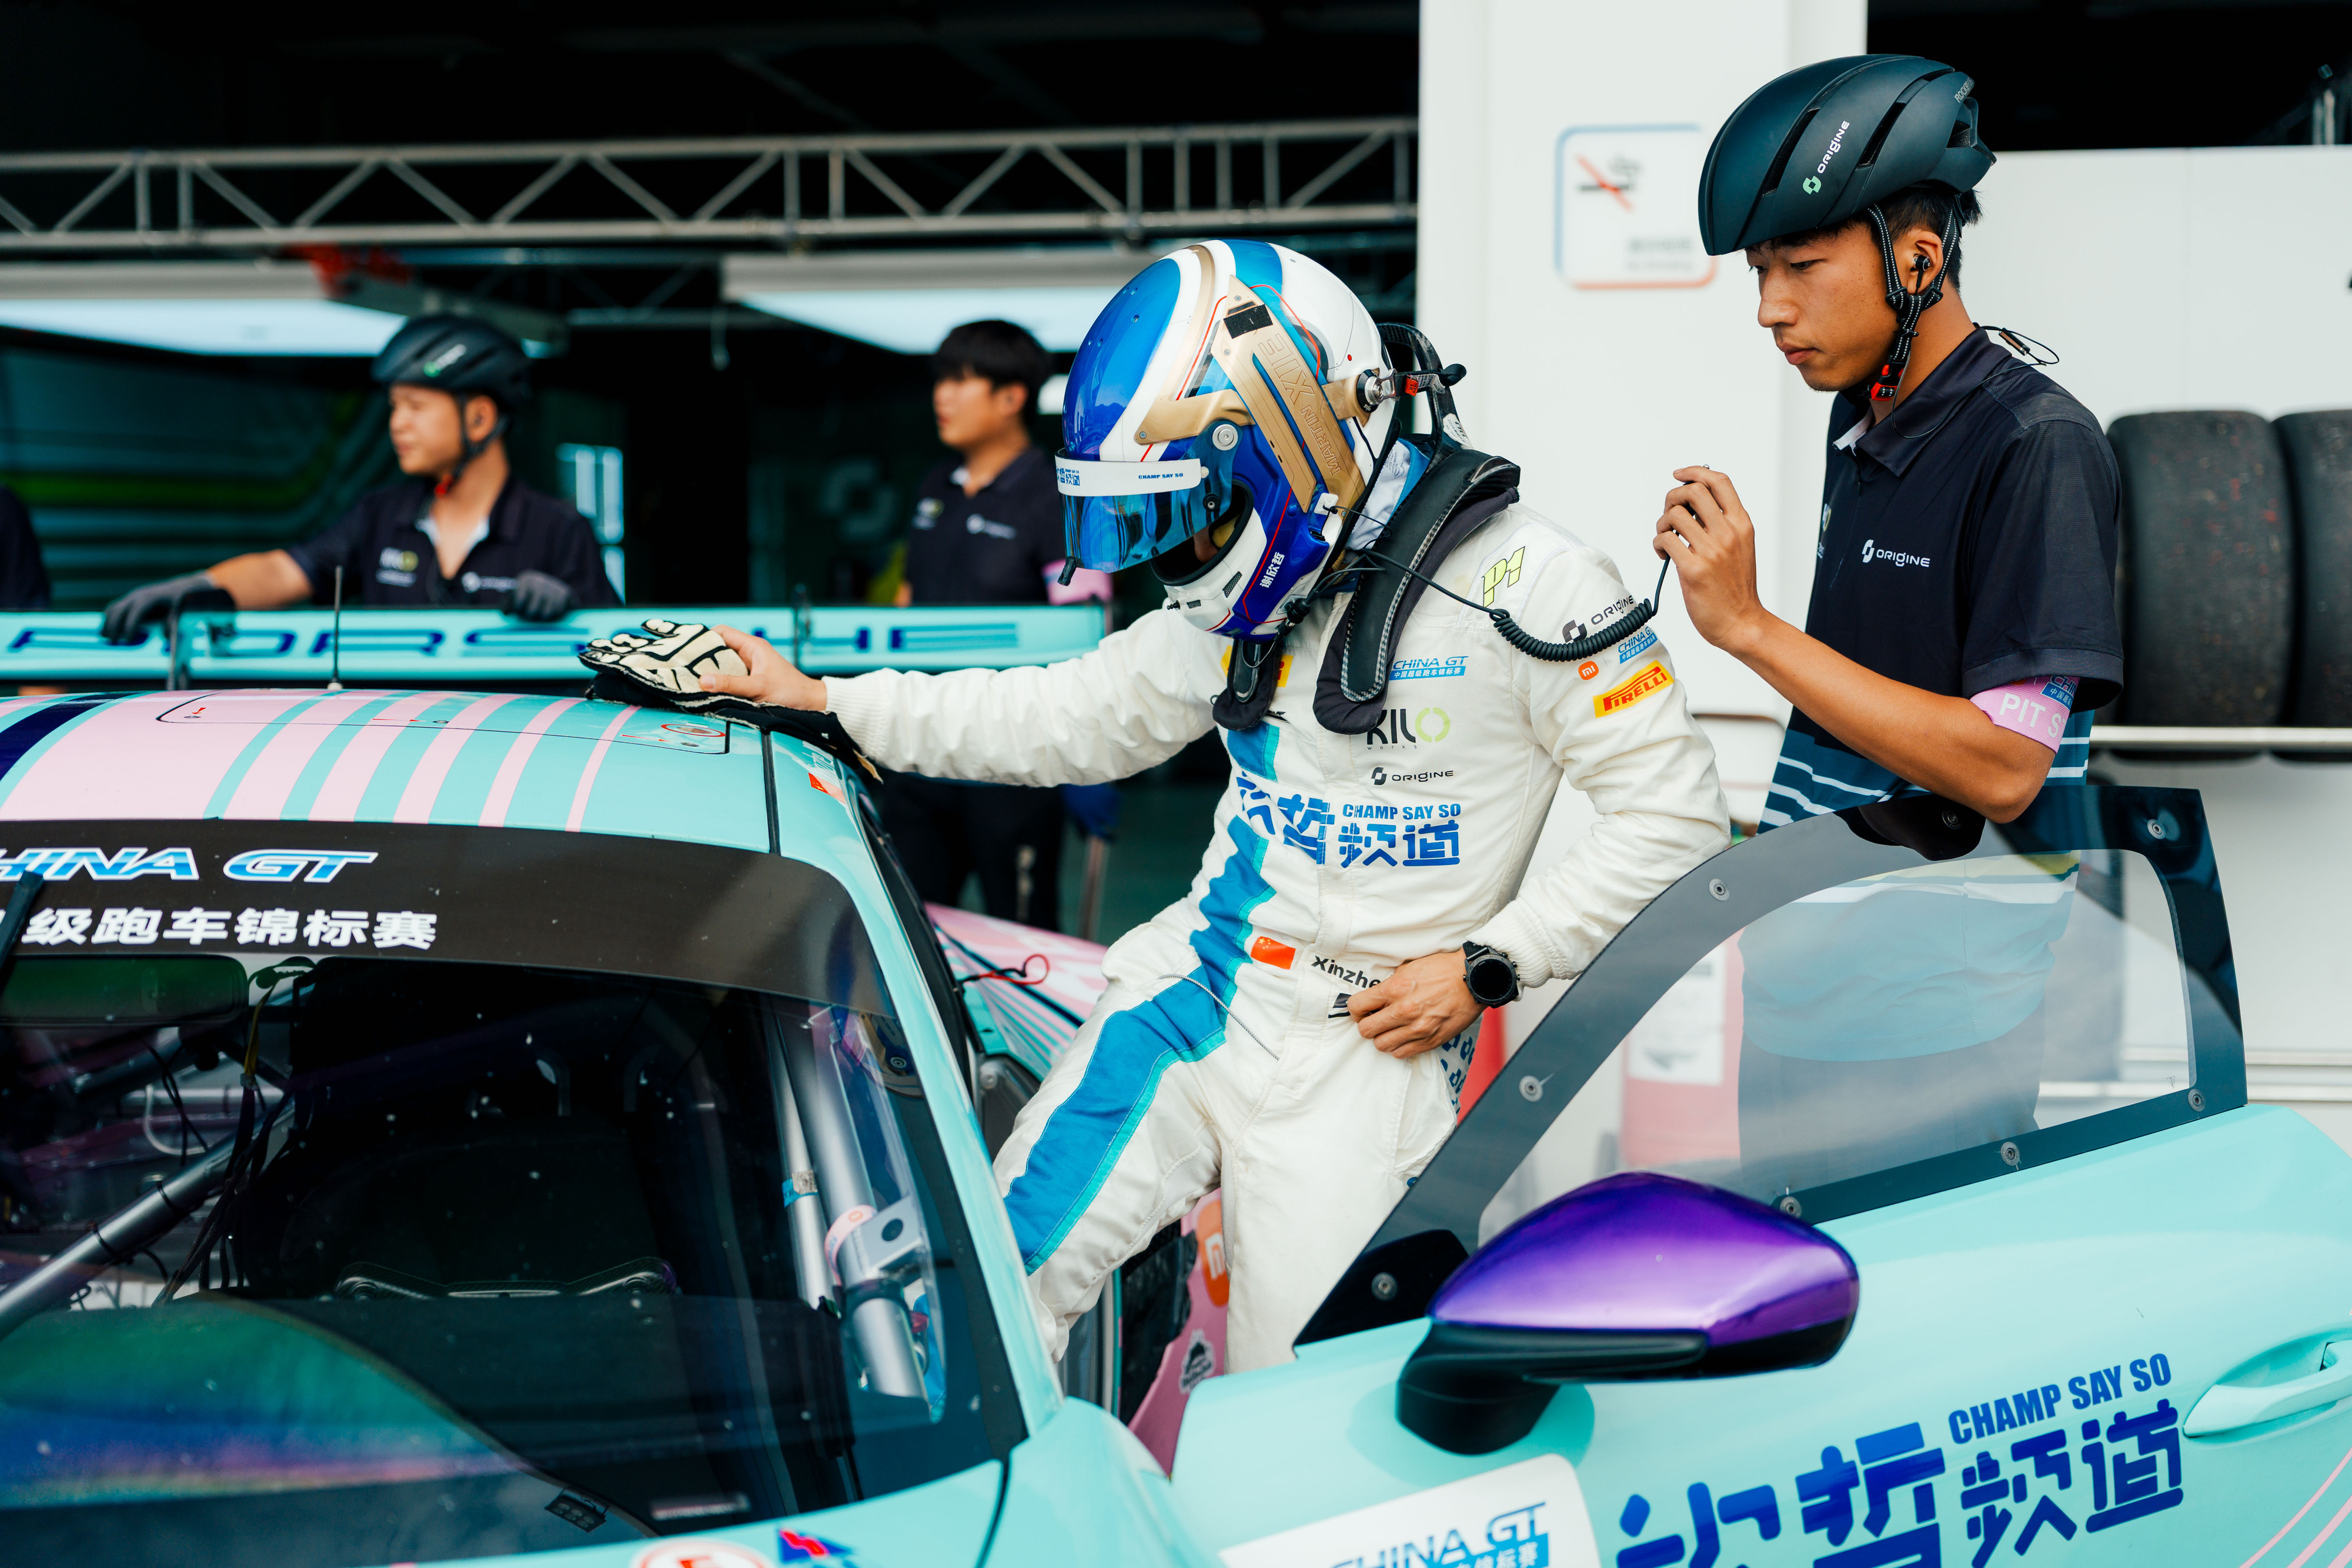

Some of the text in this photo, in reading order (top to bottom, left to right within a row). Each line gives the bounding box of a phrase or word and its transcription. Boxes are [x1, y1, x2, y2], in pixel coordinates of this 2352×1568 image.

[1258, 333, 1341, 476] MARTIN XIE
[1259, 551, 1285, 589] 谢欣哲
[7, 622, 1019, 658] PORSHE
[1618, 626, 1652, 653] CHINA G
[1392, 656, 1469, 670] CHINA GT
[1394, 667, 1462, 678] 中国超级跑车锦标赛
[1603, 666, 1668, 711] PIRELLI
[1367, 707, 1451, 745] KILO
[1999, 693, 2046, 728] PIT
[1342, 803, 1461, 820] CHAMP SAY SO
[223, 849, 379, 882] GT
[0, 907, 438, 950] 级跑车锦标赛
[1949, 1352, 2172, 1445] CHAMP SAY SO
[1329, 1501, 1546, 1568] HINA GT
